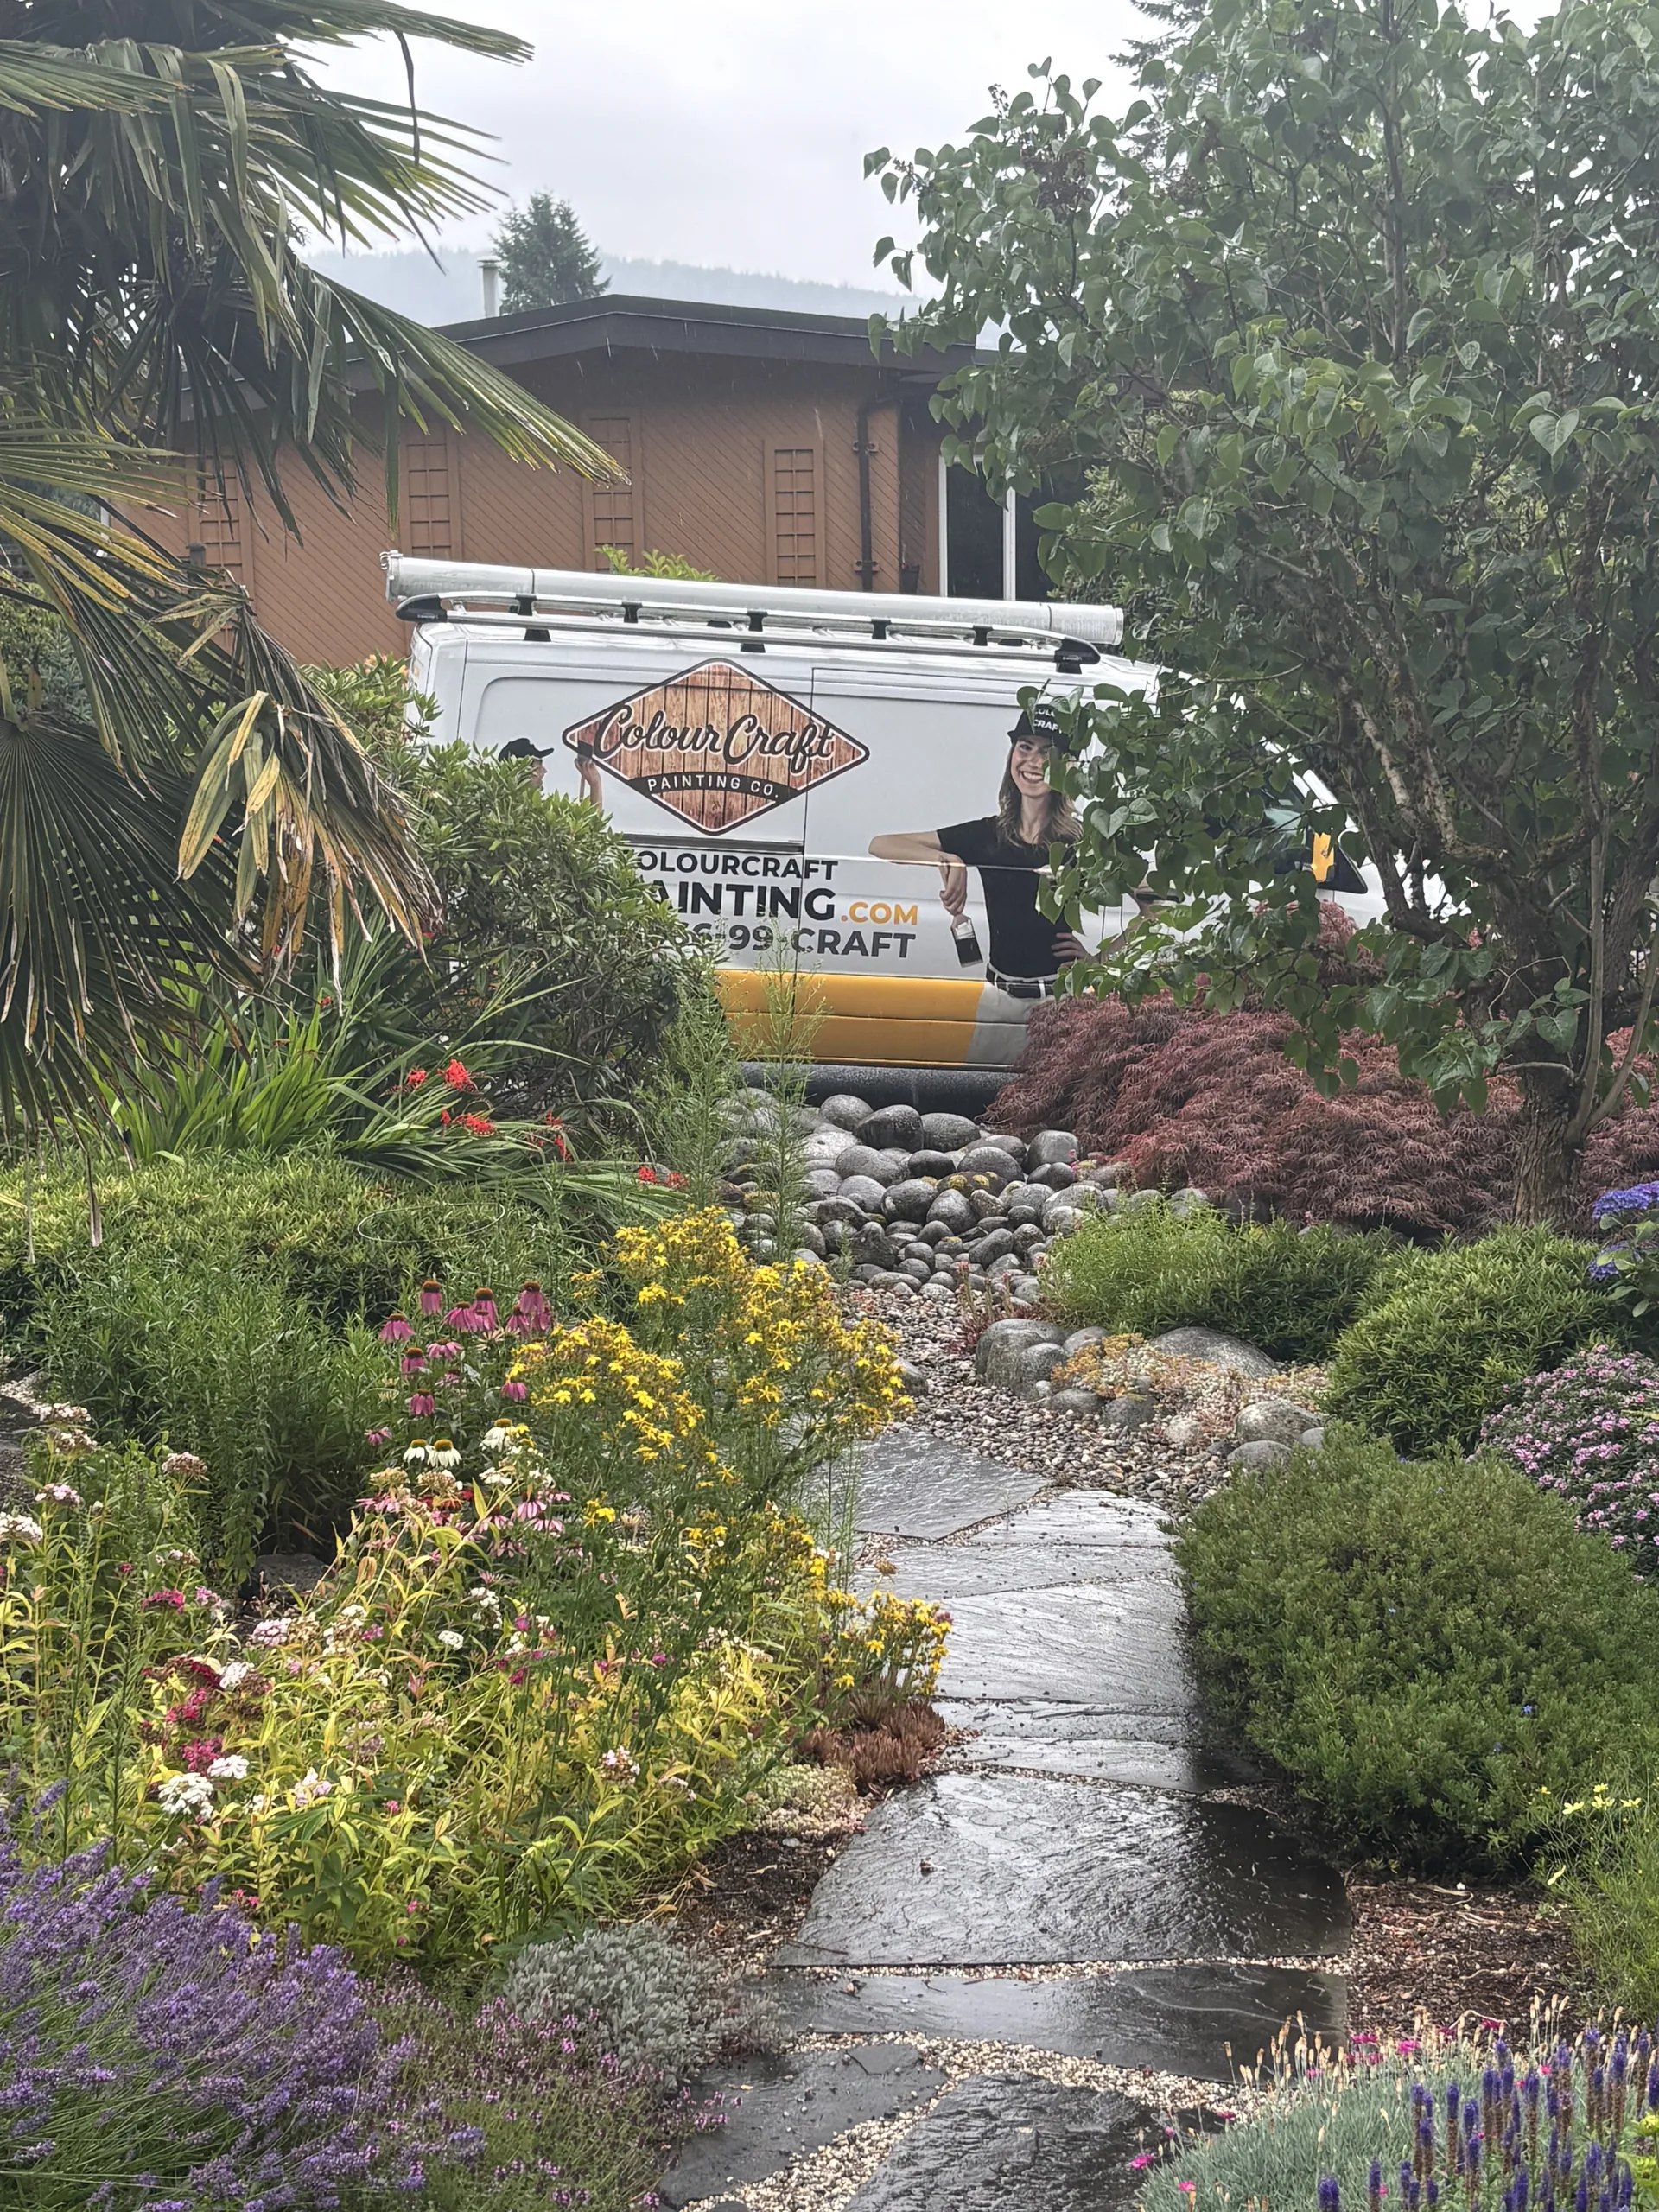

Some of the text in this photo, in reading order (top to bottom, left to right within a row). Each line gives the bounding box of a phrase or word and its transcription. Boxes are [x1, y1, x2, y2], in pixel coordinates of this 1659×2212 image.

[1033, 719, 1062, 734] CRAF
[648, 774, 779, 798] PAINTING CO.
[623, 850, 838, 880] OLOURCRAFT
